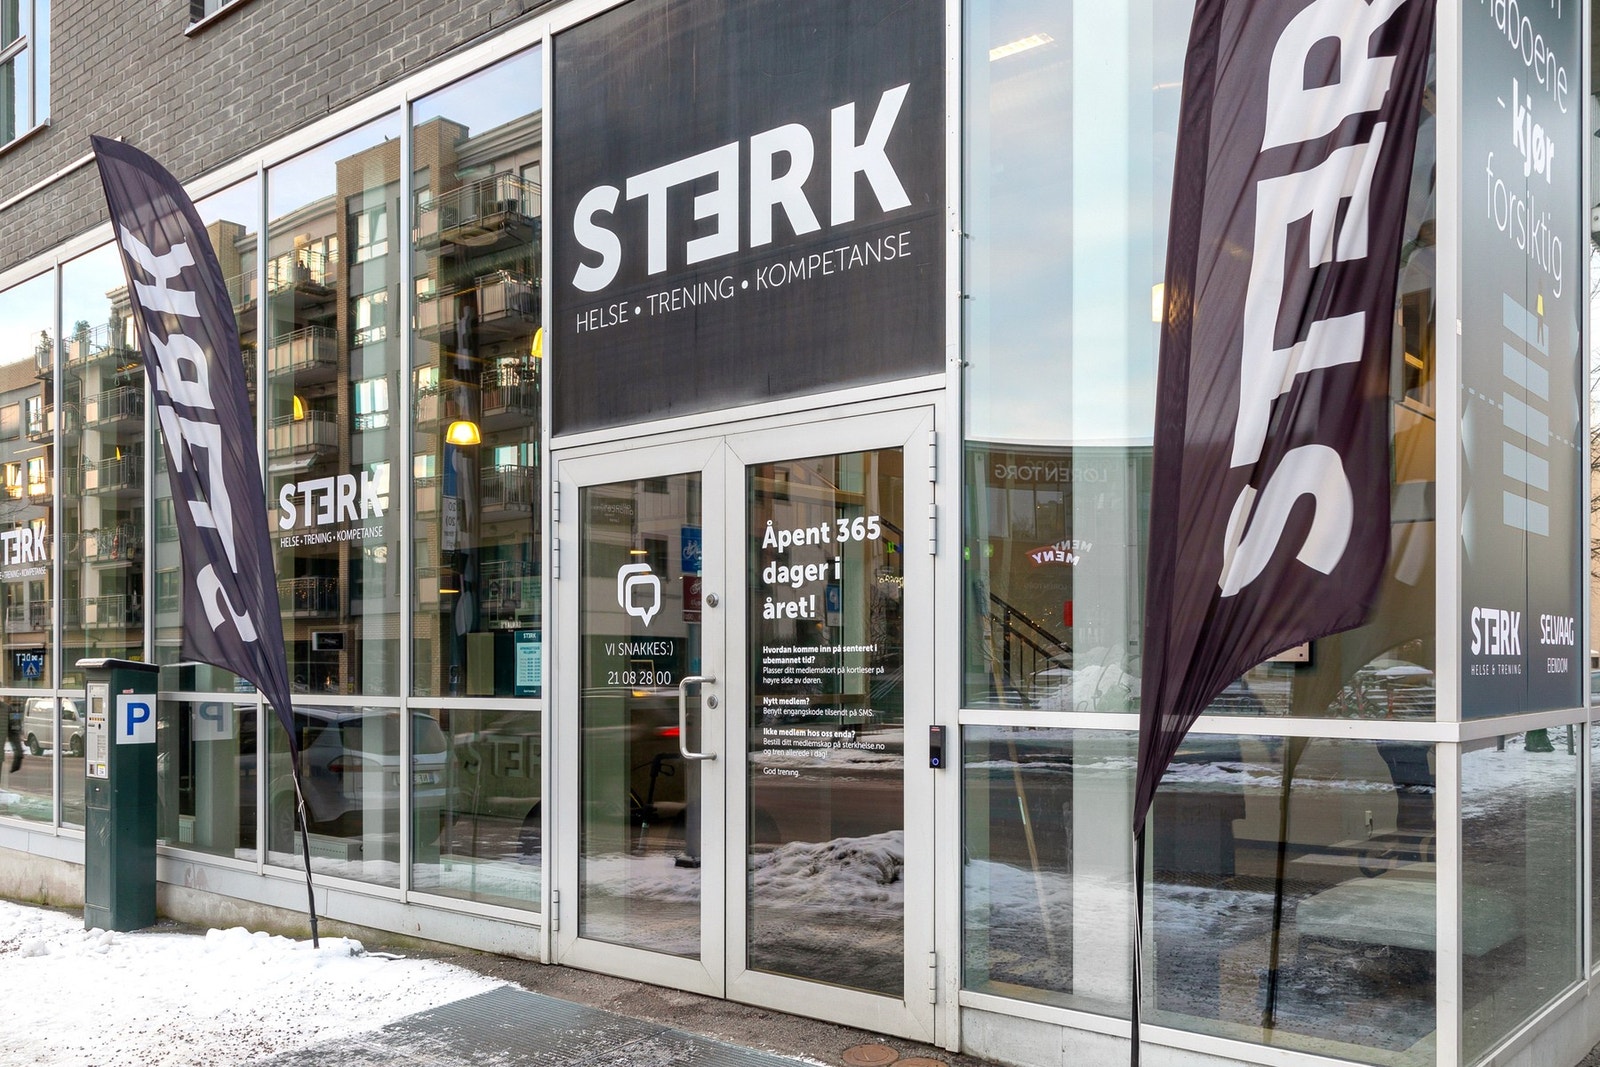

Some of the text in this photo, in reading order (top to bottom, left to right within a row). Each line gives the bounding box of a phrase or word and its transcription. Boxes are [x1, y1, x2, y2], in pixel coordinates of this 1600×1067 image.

[1481, 0, 1568, 114] aboene
[1512, 77, 1554, 184] kjør
[572, 82, 912, 292] STERK
[1486, 152, 1562, 298] forsiktig
[576, 231, 912, 334] HELSE TRENING KOMPETANSE
[279, 464, 384, 530] STERK
[280, 526, 383, 548] HELSE TRENING KOMPETANSE
[762, 516, 880, 553] Åpent 365
[762, 556, 840, 588] dager i
[762, 594, 816, 619] året!
[1471, 606, 1521, 656] STERK
[1540, 614, 1574, 646] SELVAAG
[605, 641, 674, 656] VI SNAKKES:)
[793, 645, 818, 653] komme
[833, 644, 841, 654] på
[837, 666, 845, 675] på
[876, 666, 884, 675] på
[1471, 664, 1489, 675] HELSE
[1498, 664, 1521, 675] TRENING
[1547, 657, 1568, 673] EIENDOM
[608, 671, 671, 685] 21 08 28 00
[763, 698, 778, 706] Nytt
[763, 708, 782, 716] Benytt
[783, 708, 824, 717] engangskode
[849, 708, 857, 717] på
[126, 702, 150, 736] P
[779, 728, 806, 736] medlem
[786, 749, 809, 757] allerede
[793, 739, 831, 748] medlemskap
[833, 740, 841, 749] på
[842, 742, 885, 750] sterkhelse.no
